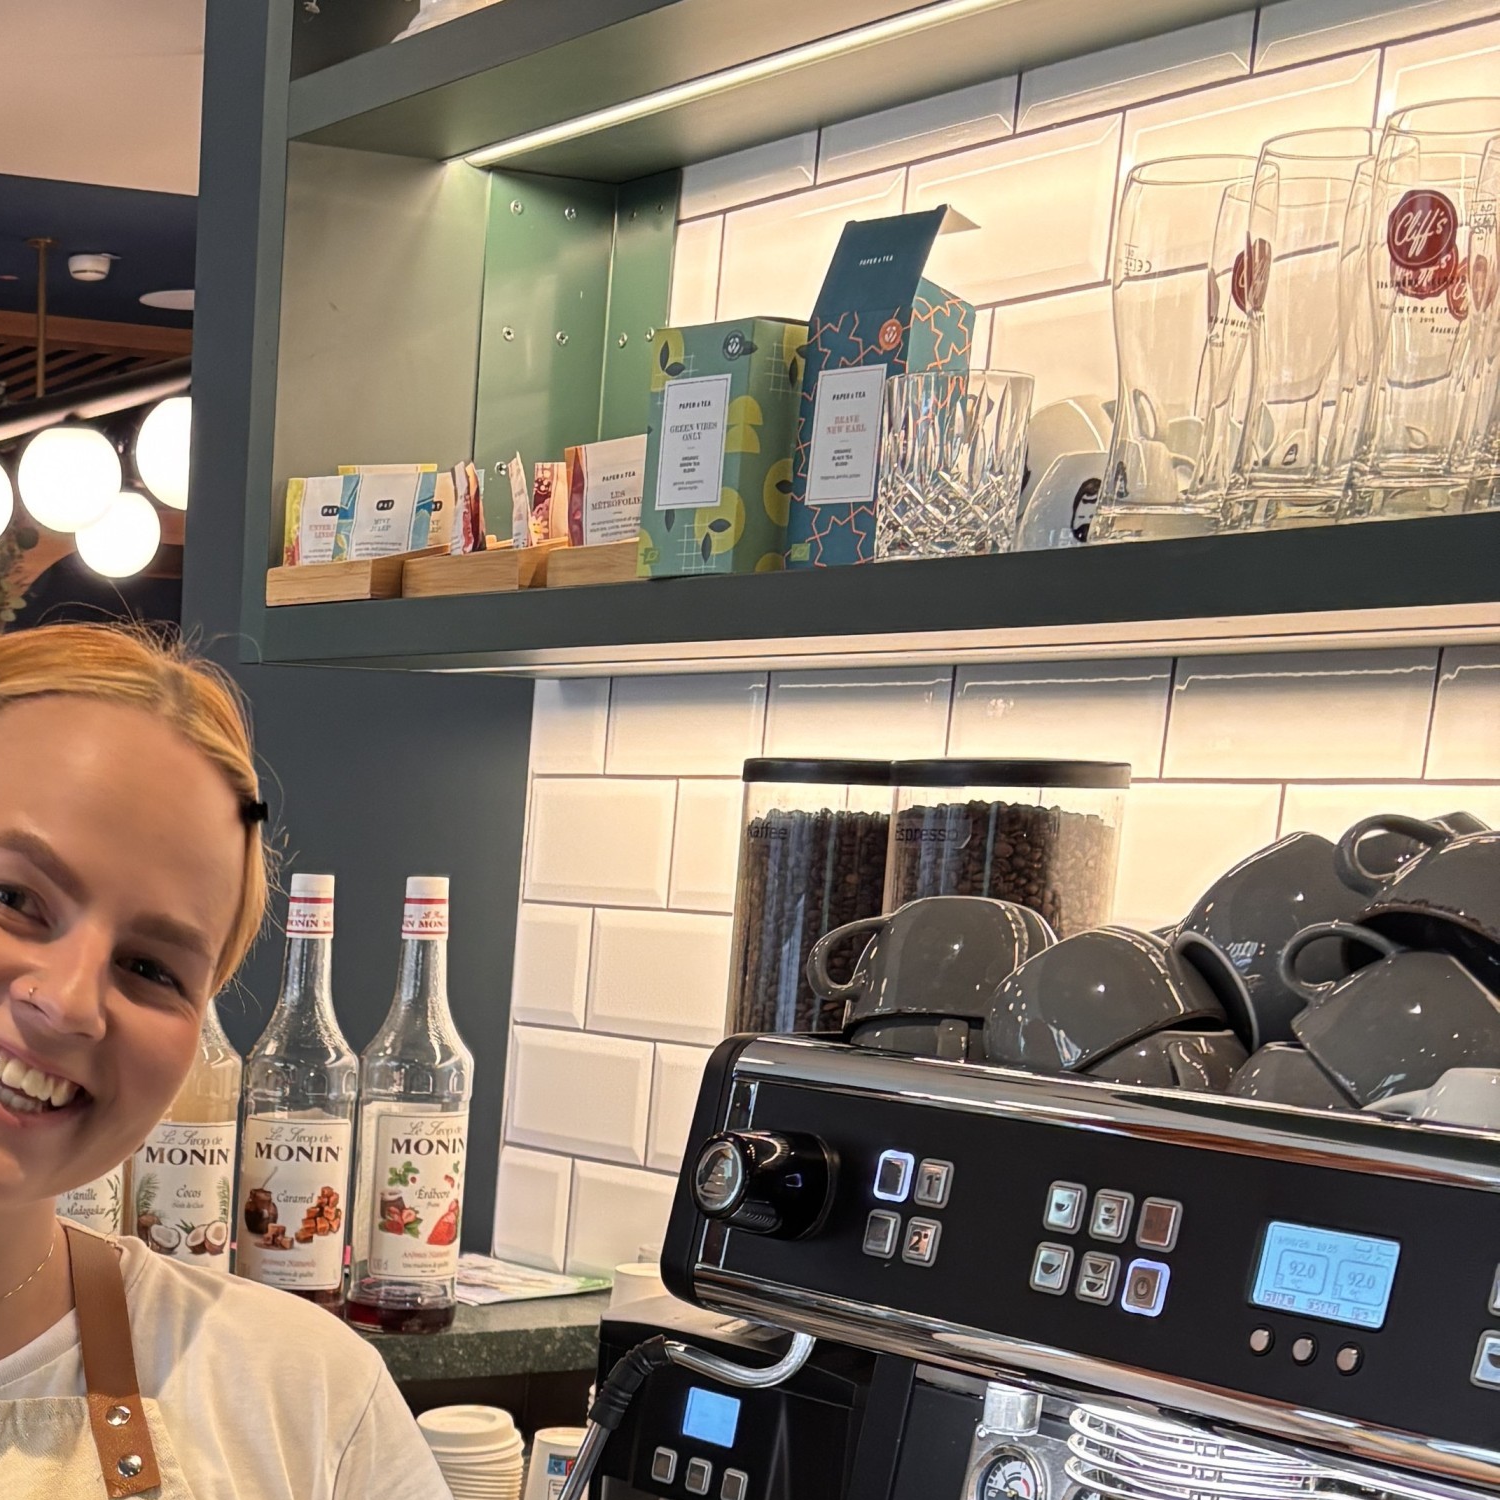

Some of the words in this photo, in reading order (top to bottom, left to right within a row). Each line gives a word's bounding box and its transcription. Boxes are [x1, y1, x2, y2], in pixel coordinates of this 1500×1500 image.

[1395, 208, 1448, 258] Cliff's
[670, 424, 693, 433] GREEN
[682, 432, 702, 441] ONLY
[747, 822, 788, 840] Kaffee
[895, 823, 958, 843] Espresso
[156, 1130, 175, 1144] Le
[178, 1130, 211, 1149] Sirop
[212, 1136, 223, 1145] de
[265, 1127, 284, 1141] Le
[285, 1127, 317, 1146] Sirop
[320, 1133, 332, 1143] de
[403, 1121, 424, 1136] Le
[425, 1121, 453, 1140] Sirop
[145, 1146, 231, 1165] MONIN
[254, 1142, 340, 1162] MONIN
[391, 1138, 464, 1155] MONIN
[276, 1190, 315, 1204] Caramel
[1289, 1260, 1316, 1278] 92.0
[1348, 1272, 1376, 1289] 92.0
